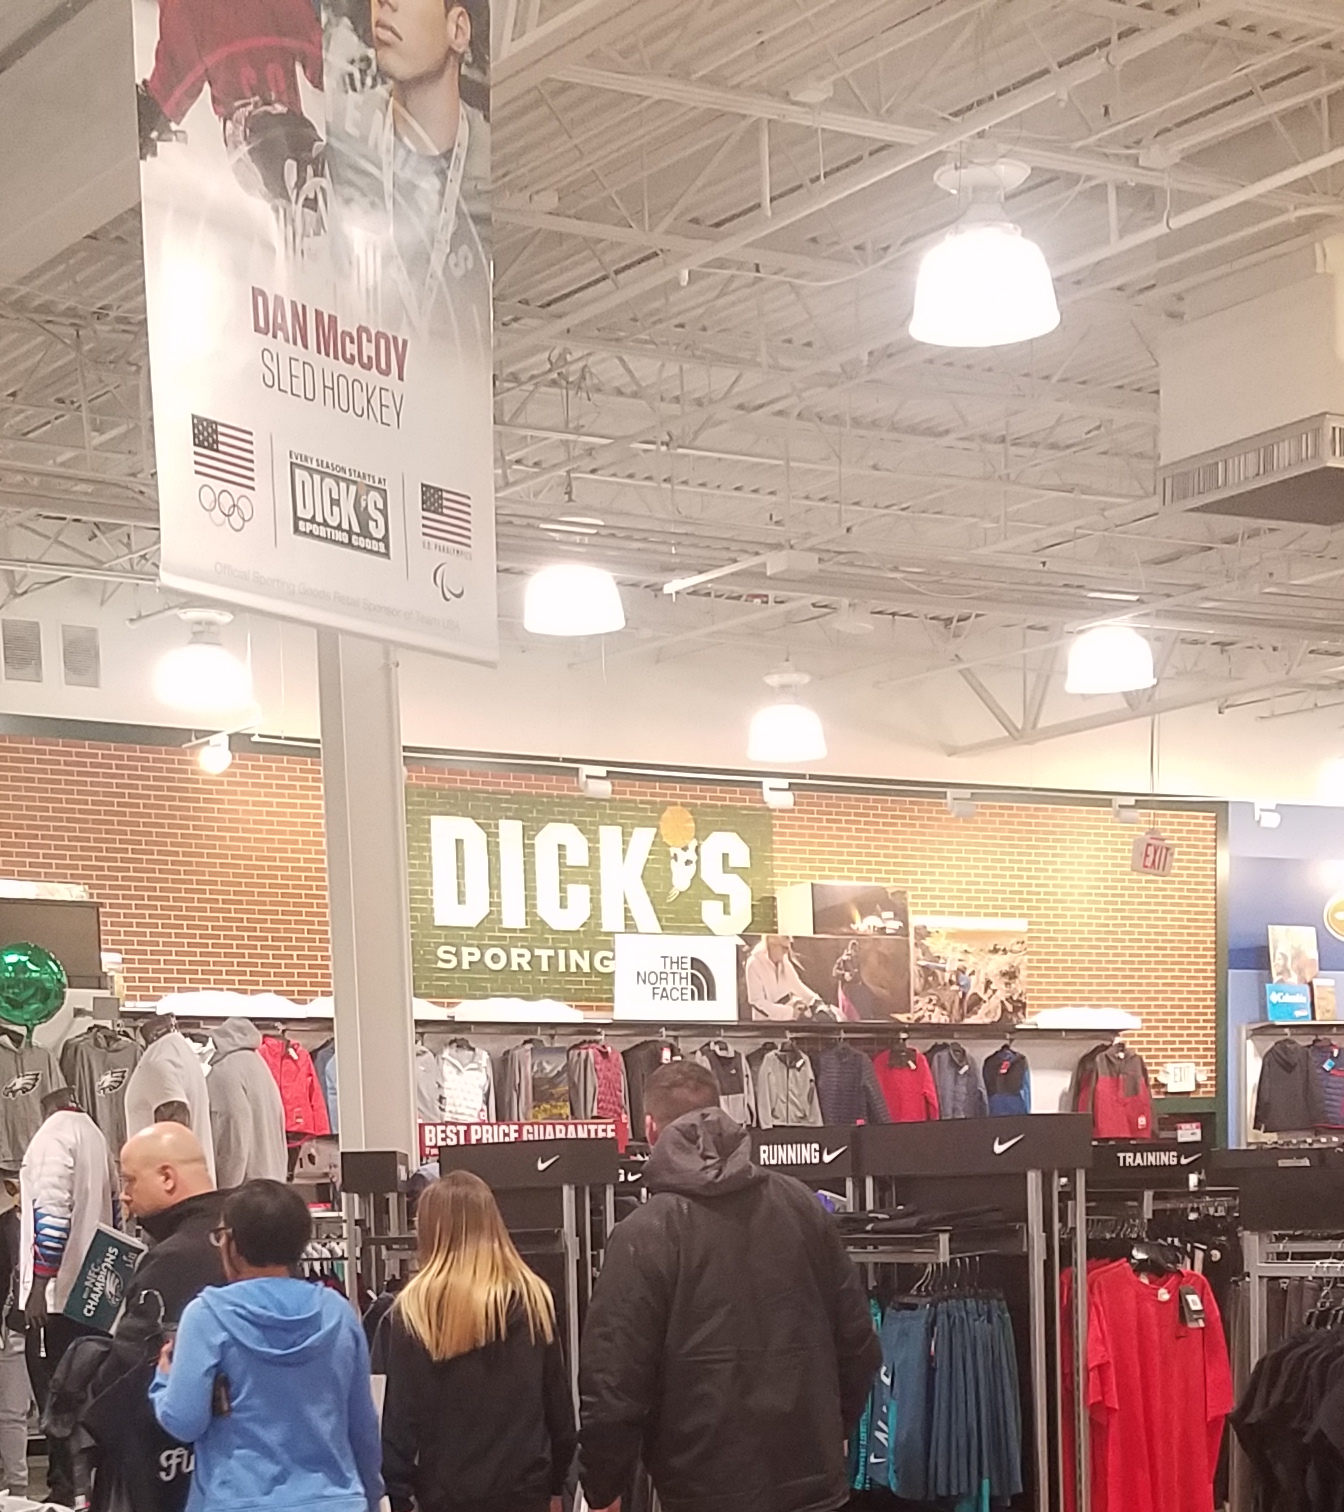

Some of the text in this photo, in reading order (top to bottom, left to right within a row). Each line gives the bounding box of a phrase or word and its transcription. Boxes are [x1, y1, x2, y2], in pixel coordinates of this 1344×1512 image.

[252, 286, 408, 382] DAN McCOY
[261, 348, 403, 429] SLED HOCKEY
[288, 450, 387, 487] EVERY SEASON STARTS AT
[294, 469, 386, 540] DICK'S
[298, 520, 349, 543] SPORTING
[1142, 843, 1171, 872] EXIT
[430, 814, 754, 936] DICK'S
[435, 945, 616, 974] SPORTING
[660, 956, 690, 970] THE
[636, 970, 690, 987] NORTH
[652, 986, 690, 1002] FACE
[424, 1124, 468, 1147] BEST
[470, 1124, 520, 1145] PRICE
[759, 1142, 821, 1166] RUNNING
[1117, 1151, 1178, 1167] TRAINING
[83, 1246, 119, 1317] CHAMPIONS
[84, 1262, 101, 1288] NFC
